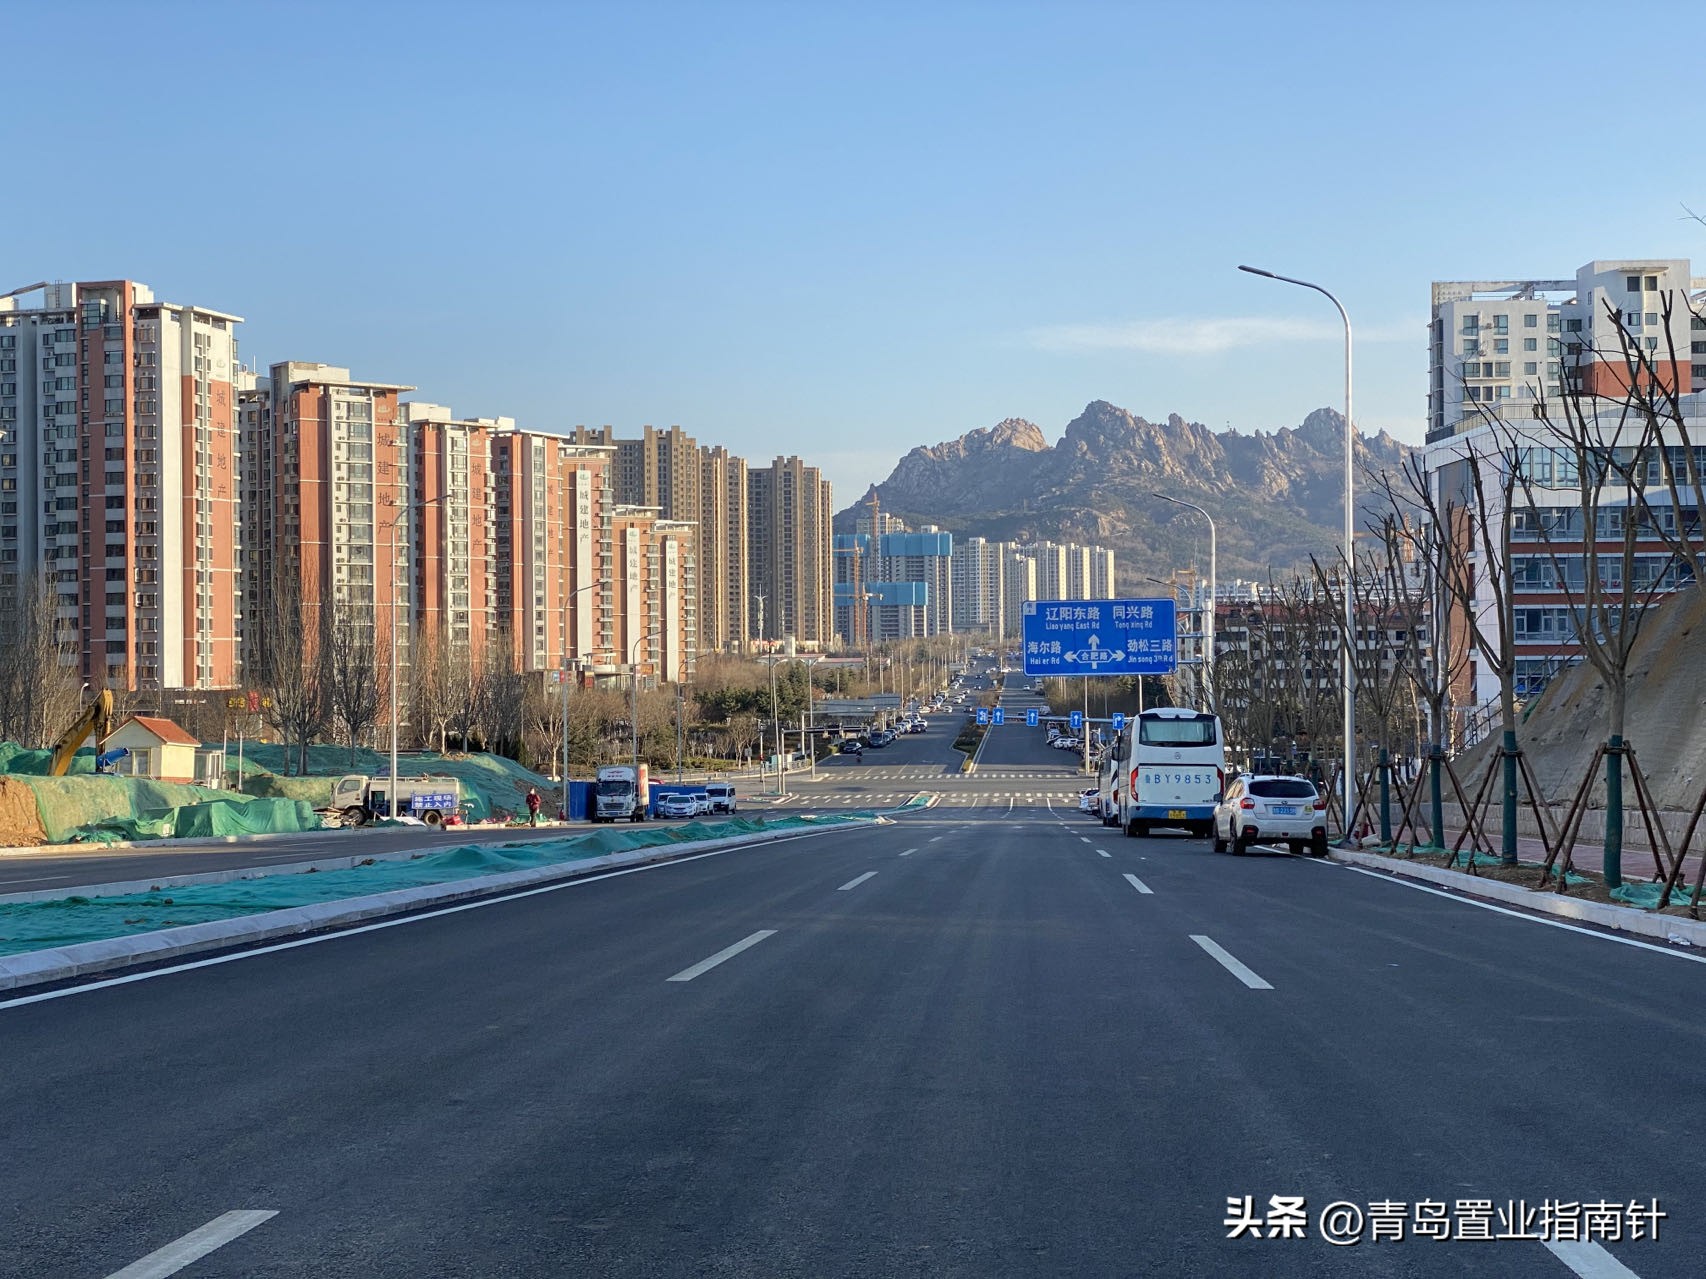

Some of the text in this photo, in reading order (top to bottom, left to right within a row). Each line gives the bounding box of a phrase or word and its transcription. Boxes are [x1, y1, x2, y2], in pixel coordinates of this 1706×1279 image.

[377, 433, 392, 535] 城建地产
[471, 463, 482, 551] 城建地产
[579, 491, 589, 544] 城建地产
[1046, 606, 1100, 620] 辽阳东路
[1113, 605, 1153, 619] 同兴路
[1075, 621, 1090, 630] East
[1091, 621, 1100, 629] Rd
[1145, 620, 1153, 629] Rd
[1027, 641, 1061, 654] 海尔路
[1127, 639, 1172, 652] 劲松三路
[1051, 657, 1060, 665] Rd
[1081, 652, 1107, 660] 合肥路
